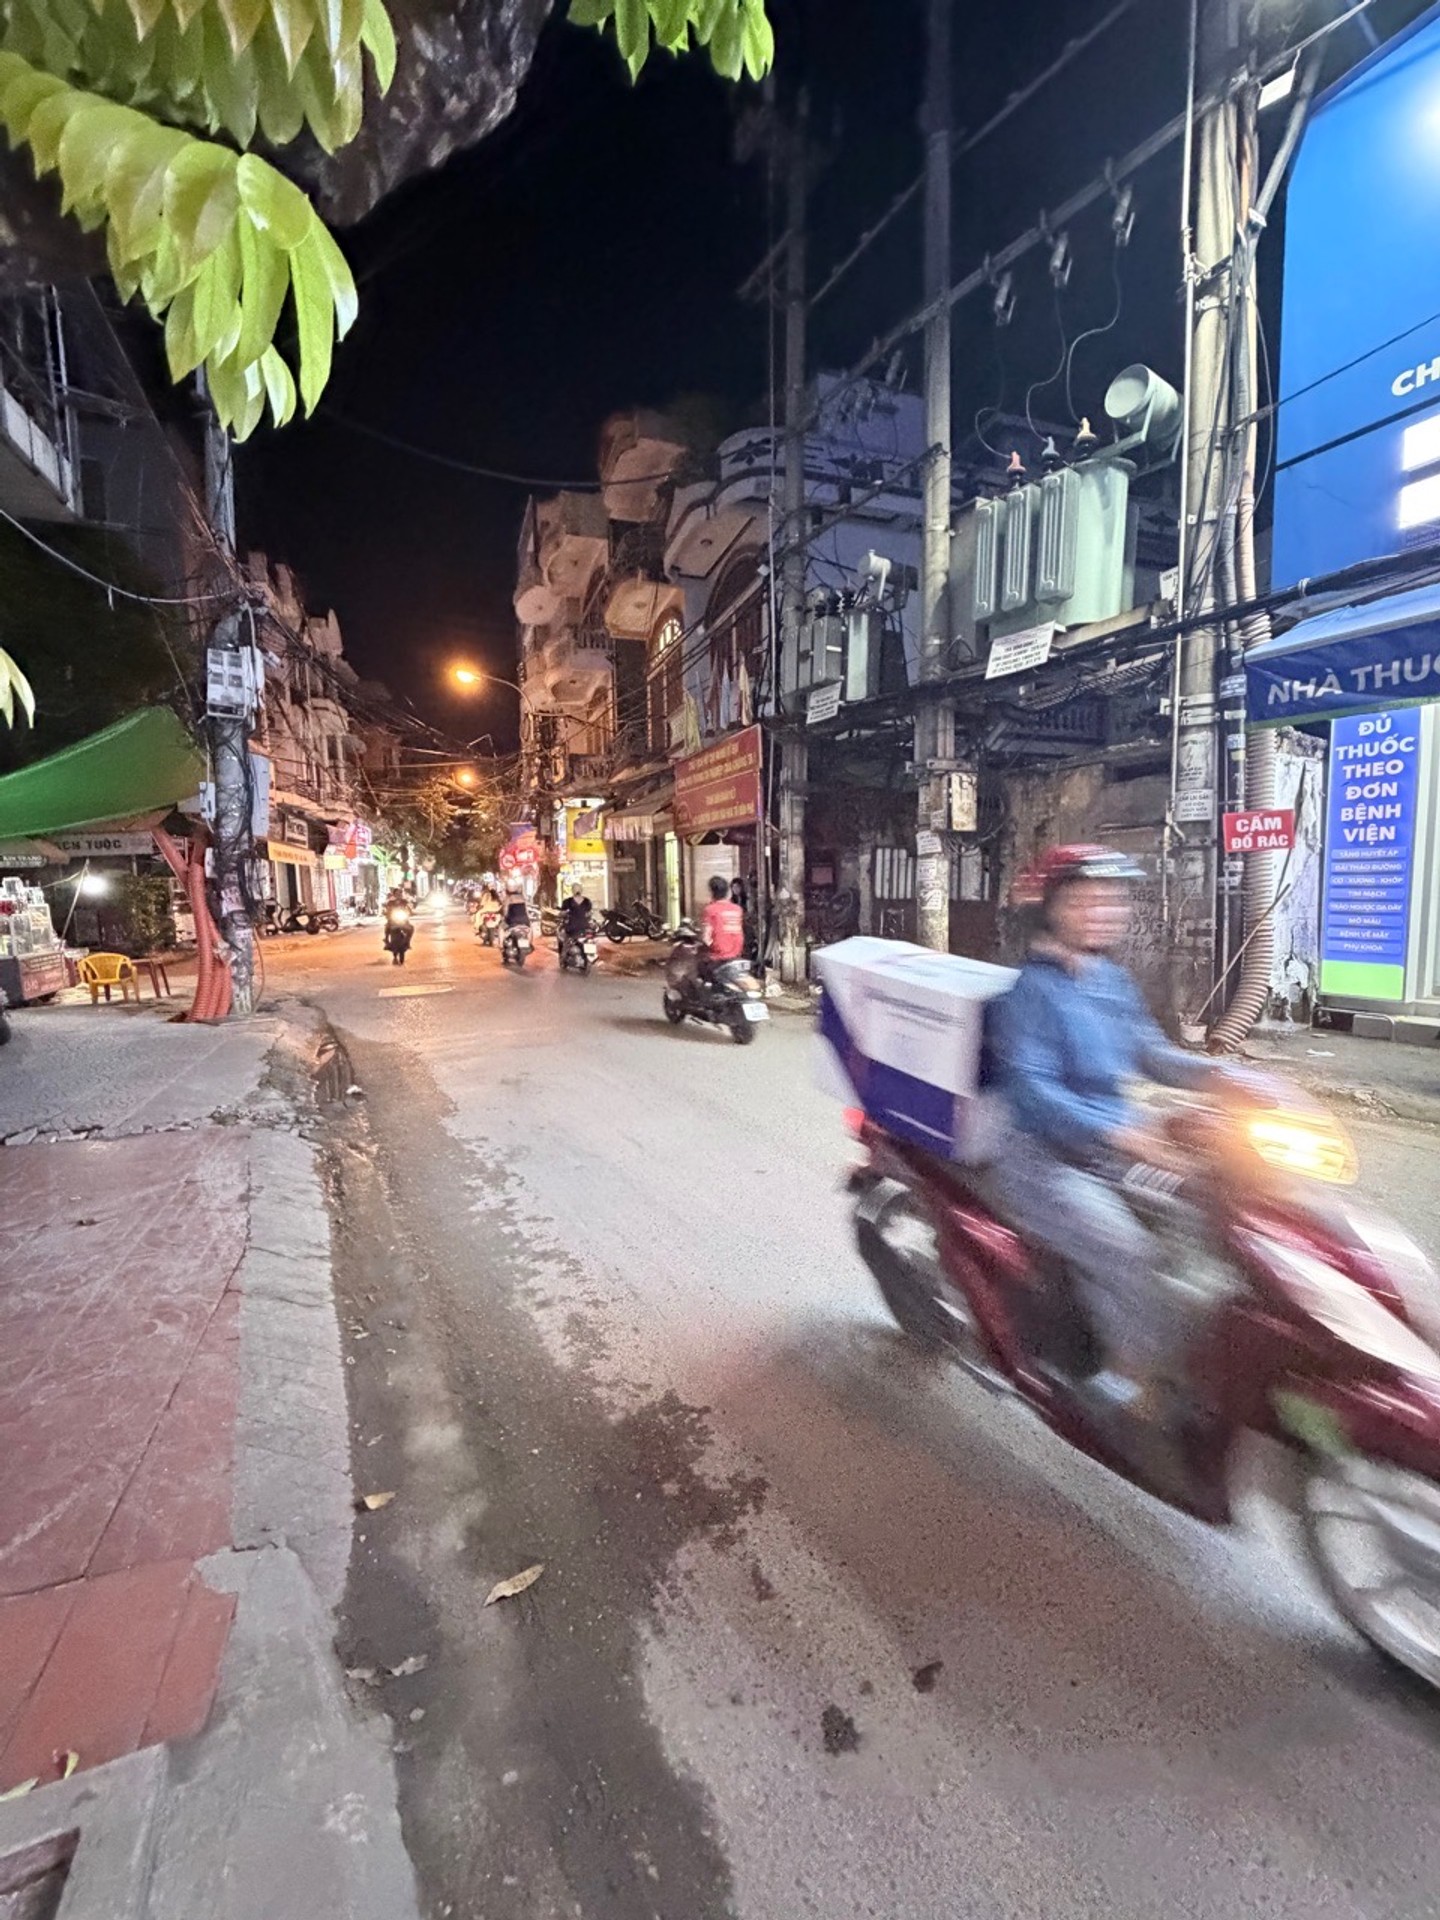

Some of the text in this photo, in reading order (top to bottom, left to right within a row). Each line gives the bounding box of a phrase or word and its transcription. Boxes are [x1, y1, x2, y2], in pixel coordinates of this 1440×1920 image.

[1267, 667, 1343, 705] NHÀ
[1350, 654, 1440, 691] THU
[1358, 713, 1392, 736] ĐỦ
[1335, 733, 1415, 760] THUỐC
[1342, 759, 1404, 779] THEO
[1345, 781, 1398, 800] ĐƠN
[1235, 813, 1282, 833] CẤM
[1341, 802, 1401, 825] BỆNH
[1257, 832, 1289, 847] RÁC
[1343, 823, 1396, 846] VIỆN
